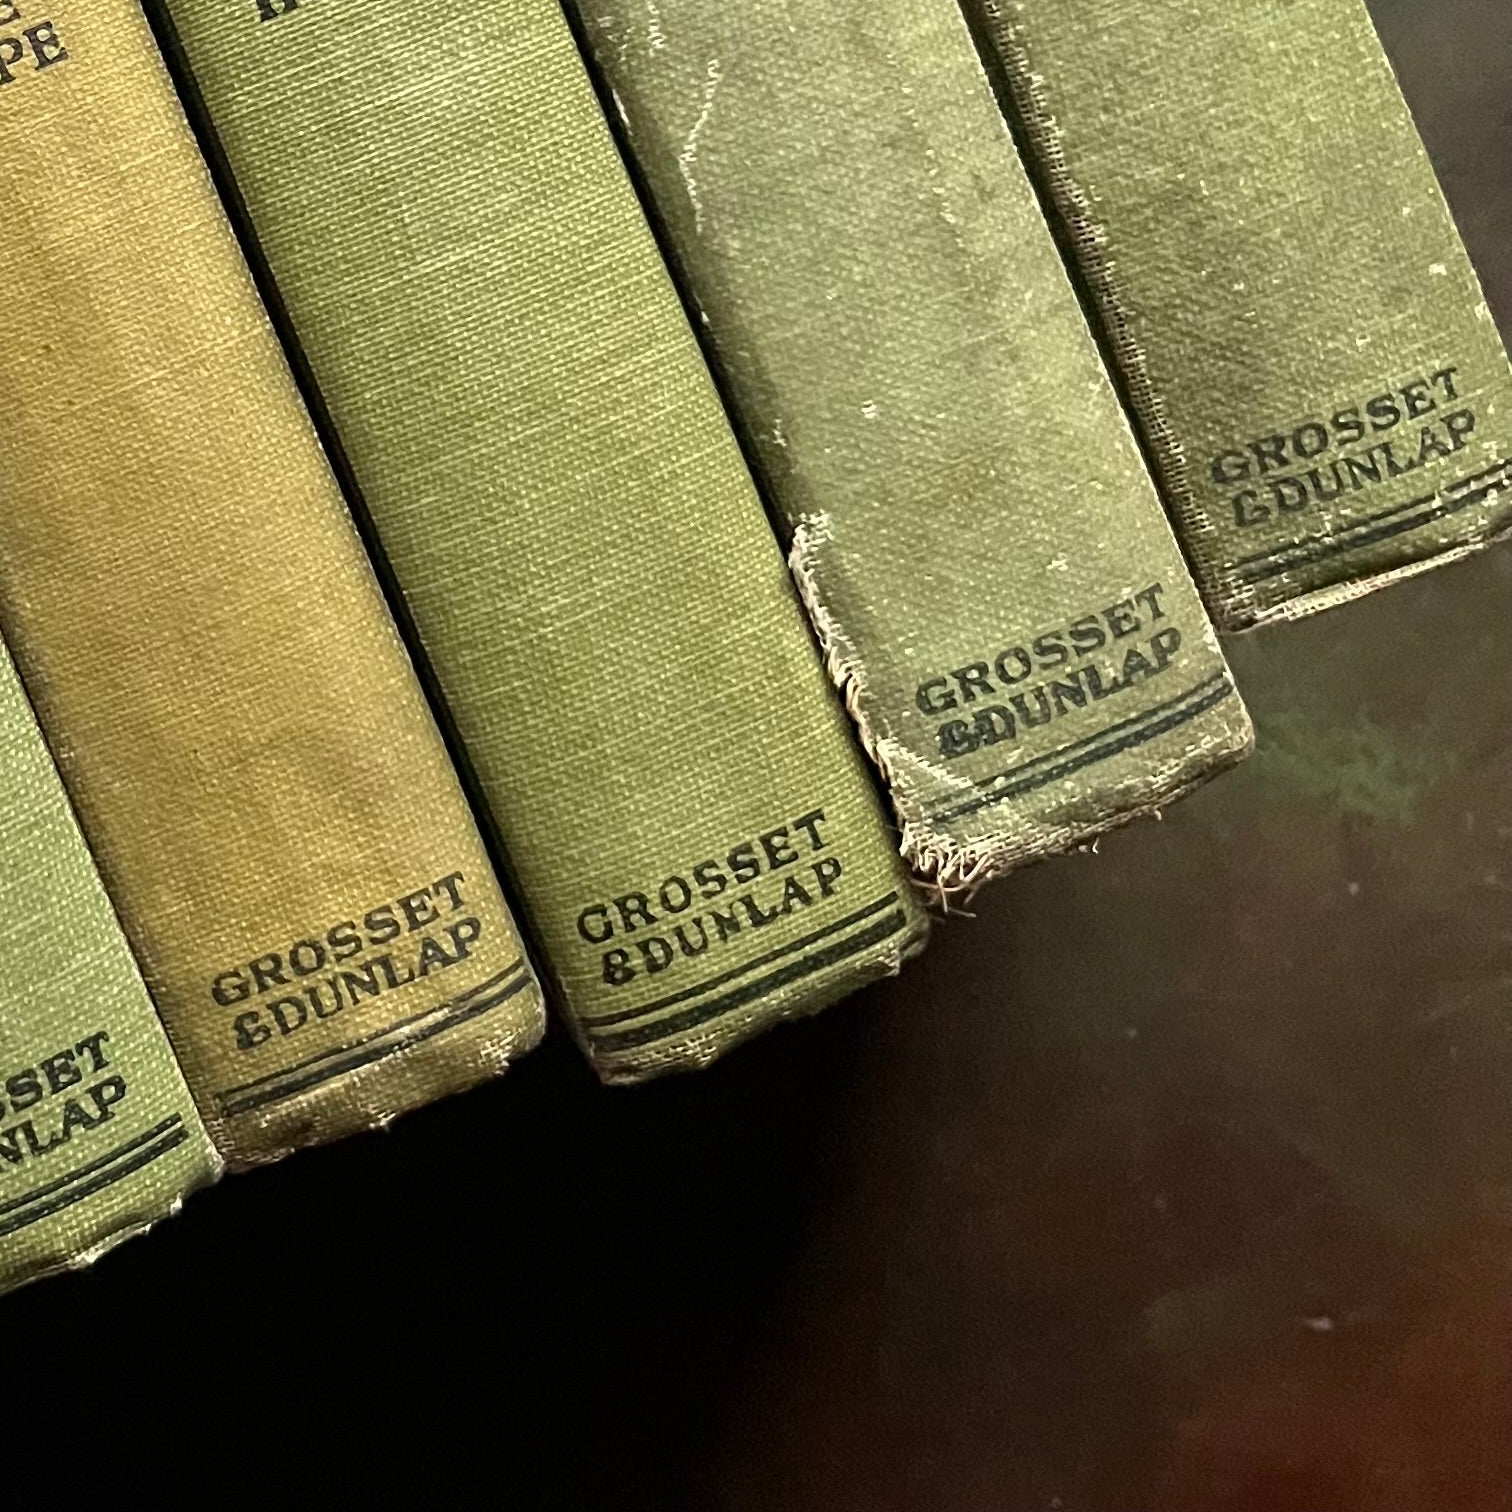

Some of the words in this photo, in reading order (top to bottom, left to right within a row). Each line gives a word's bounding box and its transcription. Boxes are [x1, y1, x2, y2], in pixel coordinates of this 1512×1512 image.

[1212, 367, 1458, 484] GROSSET
[916, 583, 1165, 716] GROSSET
[211, 870, 464, 1007] GROSSET
[577, 808, 829, 944] GROSSET
